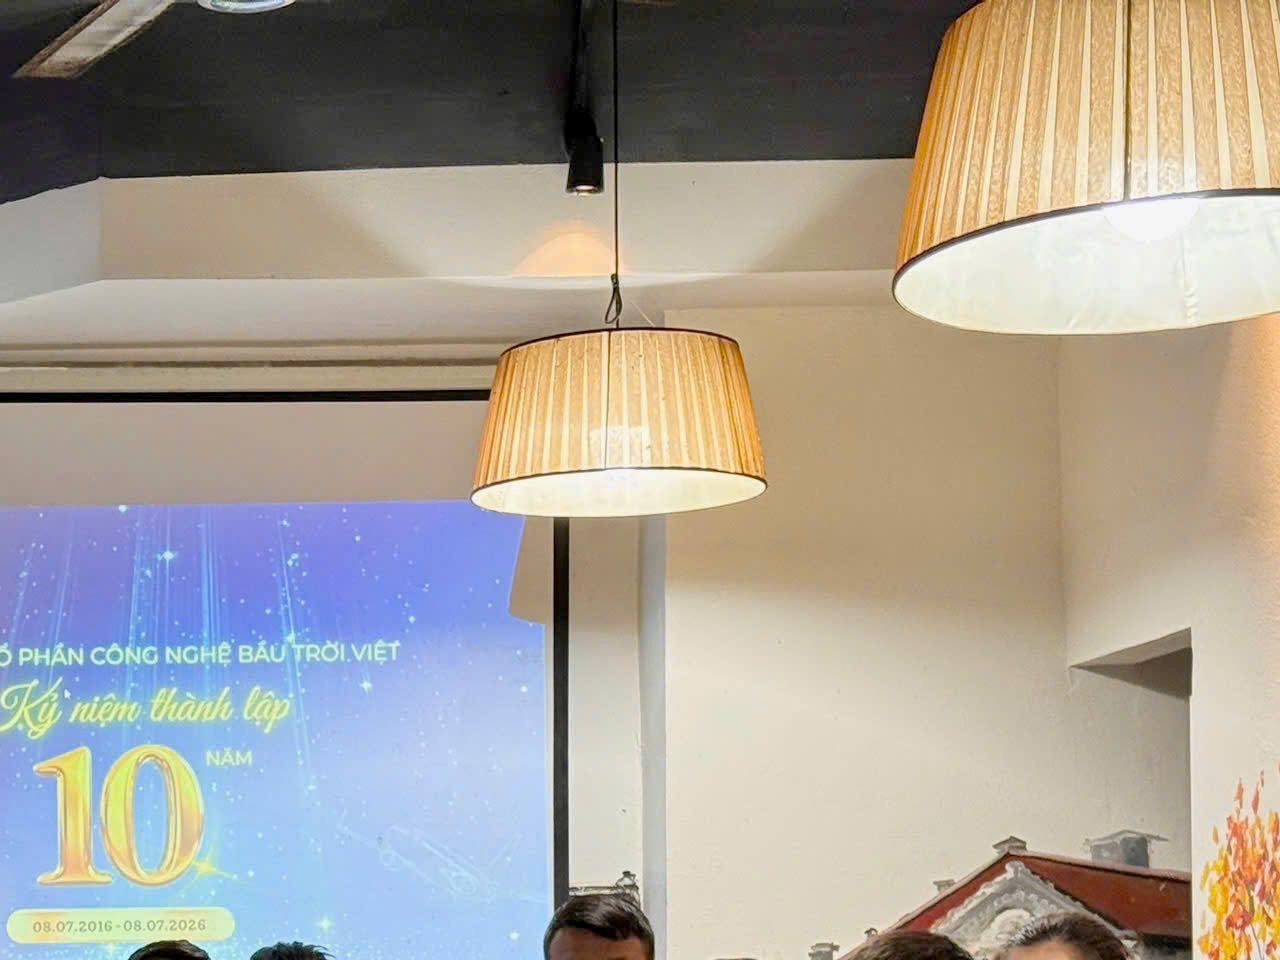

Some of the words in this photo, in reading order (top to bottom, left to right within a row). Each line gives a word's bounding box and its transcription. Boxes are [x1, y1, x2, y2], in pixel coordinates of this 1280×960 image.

[90, 642, 159, 666] CÔNG
[165, 641, 232, 668] NGHỆ
[291, 640, 346, 664] TRỜI
[351, 639, 401, 665] VIỆT
[69, 692, 142, 728] niệm
[150, 686, 235, 723] thành
[243, 685, 290, 734] lập
[205, 747, 253, 767] NĂM
[32, 744, 206, 887] 10
